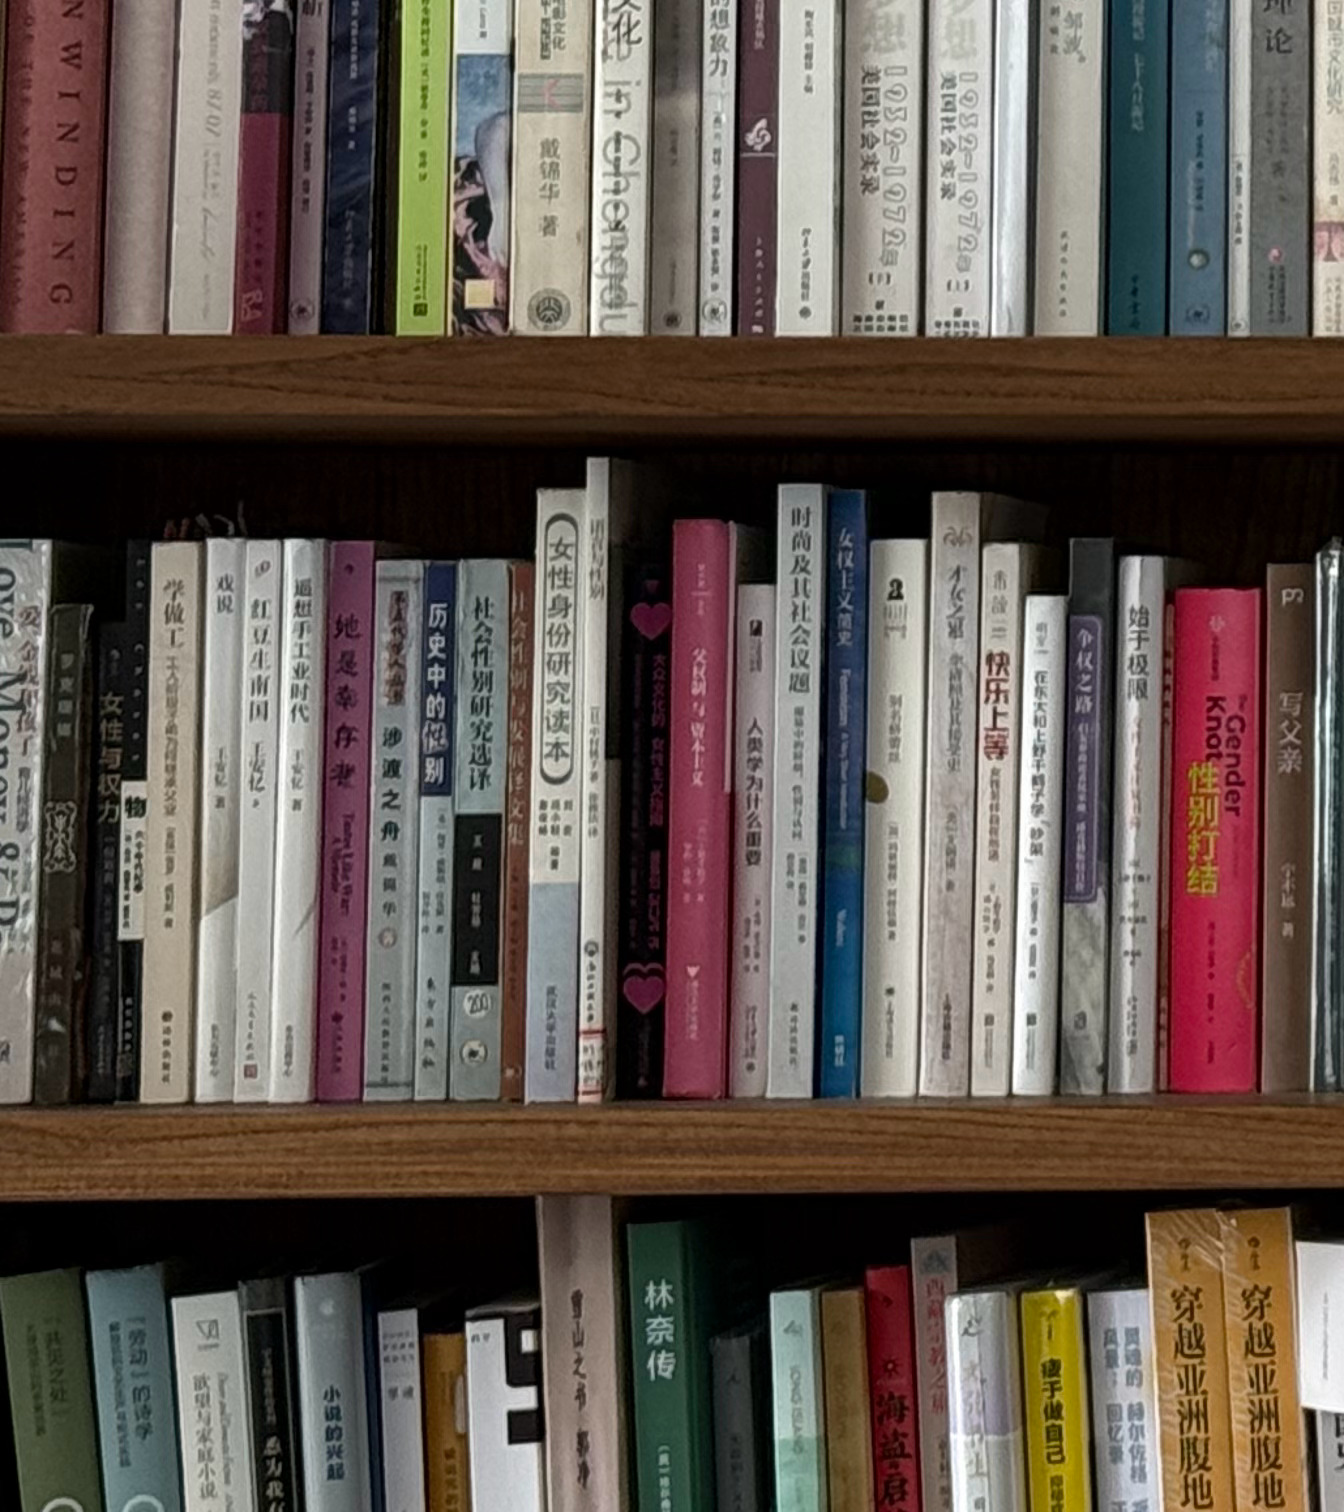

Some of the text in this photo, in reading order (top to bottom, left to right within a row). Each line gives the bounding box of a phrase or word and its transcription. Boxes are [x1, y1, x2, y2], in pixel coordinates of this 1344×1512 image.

[538, 138, 561, 205] 戴锦华
[163, 578, 185, 648] 学做工
[250, 598, 272, 723] 红豆生南国
[546, 537, 573, 765] 女性身份研究读本
[789, 507, 813, 694] 时尚及其社会议题
[1128, 606, 1150, 702] 始于极限
[422, 603, 449, 784] 历史中的性别
[469, 596, 493, 792] 社会性别研究选译
[983, 650, 1010, 762] 快乐上等
[1075, 628, 1093, 714] 争权之路
[98, 693, 121, 824] 女性与权力
[746, 718, 763, 866] 人类学为什么重要
[1206, 697, 1247, 818] Gender Knot
[1279, 691, 1303, 775] 写父亲
[1187, 762, 1220, 897] 性别打结
[644, 1279, 677, 1381] 林奈传
[322, 1384, 345, 1481] 小说的兴起
[1040, 1357, 1066, 1465] 疲于做自己
[1171, 1286, 1214, 1510] 穿越亚洲腹地
[1241, 1284, 1286, 1510] 穿越亚洲腹地
